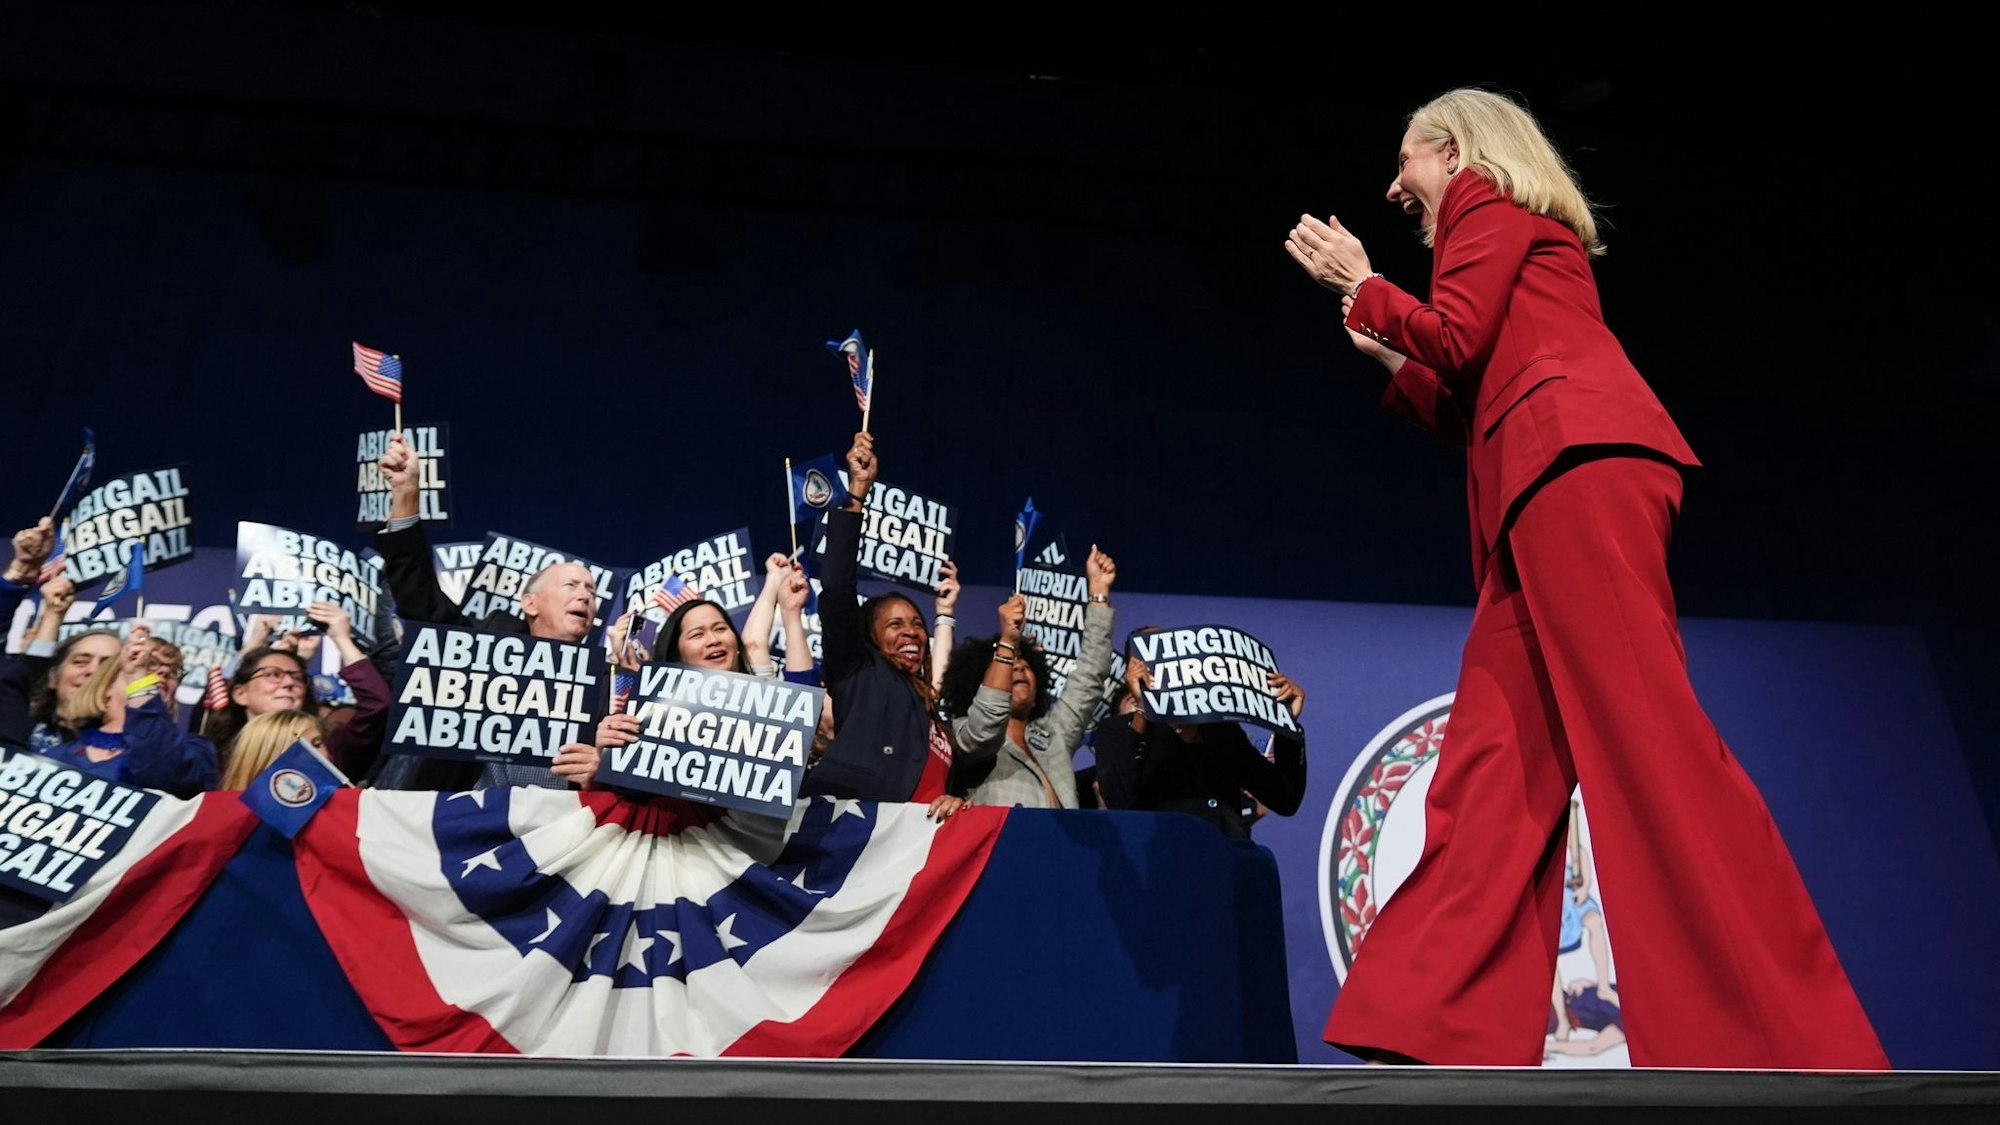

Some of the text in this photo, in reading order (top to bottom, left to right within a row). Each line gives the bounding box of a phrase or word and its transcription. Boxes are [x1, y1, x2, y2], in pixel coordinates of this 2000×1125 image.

[357, 427, 444, 462] ABIAIL
[357, 458, 446, 492] ABIIL
[838, 470, 952, 535] IGAIL
[357, 490, 448, 522] ABIIL
[272, 529, 383, 595] BIGAIL
[816, 534, 944, 591] IGAIL
[822, 507, 949, 563] IGAIL
[482, 536, 614, 600] ABIIL
[626, 533, 748, 599] ABIGAIL
[627, 556, 752, 617] ABGAIL
[1021, 567, 1088, 603] VIRGINI
[405, 627, 597, 686] ABIGAIL
[1133, 627, 1279, 674] VIRGINIA
[1152, 655, 1281, 698] VIRGINI
[398, 666, 591, 723] ABIGAIL
[638, 665, 814, 727] VIRGINIA
[1144, 684, 1298, 733] VIRGINIA
[391, 706, 580, 758] ABIGAIL
[626, 700, 804, 767] VIRGINIA
[611, 741, 793, 806] VIRGINIA
